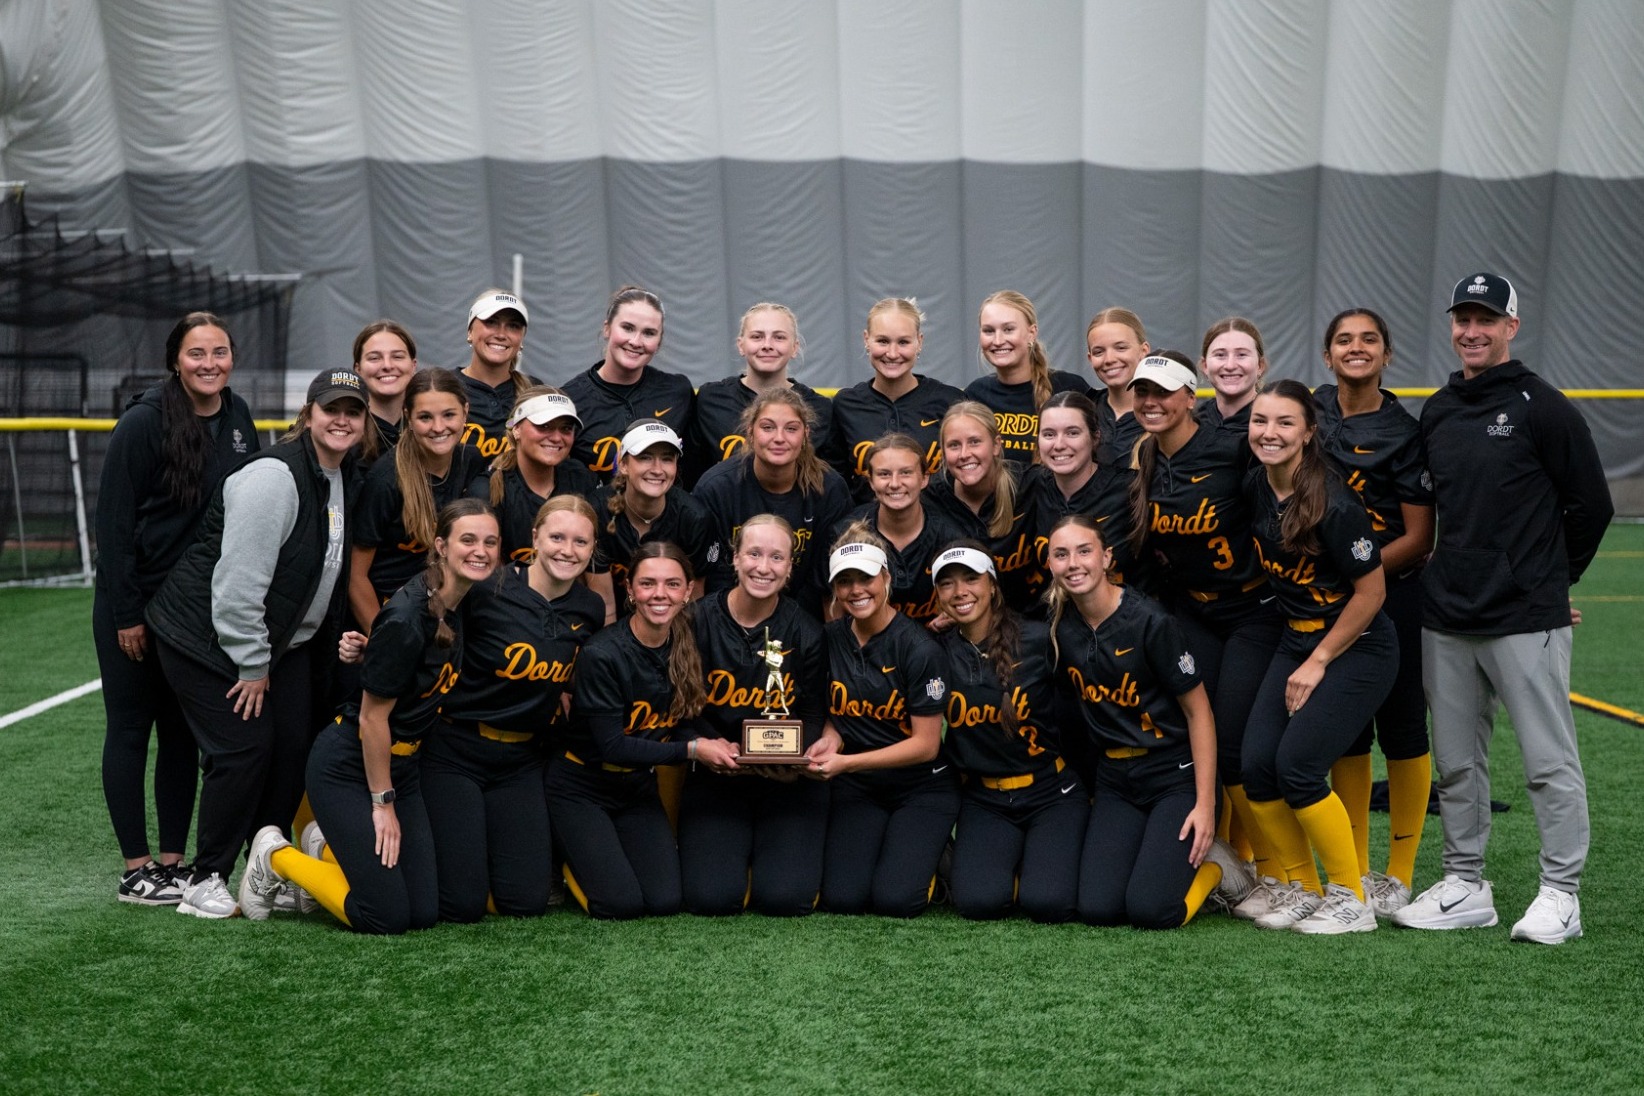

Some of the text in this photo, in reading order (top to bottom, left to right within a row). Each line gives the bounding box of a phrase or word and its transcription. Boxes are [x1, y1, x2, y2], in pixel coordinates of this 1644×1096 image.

[1467, 284, 1489, 293] DORDT
[495, 295, 517, 304] DORDT
[1145, 358, 1169, 366] DORDT
[331, 371, 359, 382] DORDT
[331, 380, 360, 389] SOFTBALL
[547, 395, 569, 404] DORDT
[645, 424, 668, 433] DORDT
[994, 413, 1039, 436] ORDT
[1487, 425, 1514, 433] DORDT
[460, 422, 511, 458] Dor
[840, 544, 864, 556] DORDT
[942, 549, 966, 561] DORDT
[1207, 535, 1235, 571] 3
[1067, 666, 1140, 707] Dordt
[829, 680, 907, 720] Dordt
[762, 731, 784, 740] GPAC
[1019, 725, 1046, 757] 2
